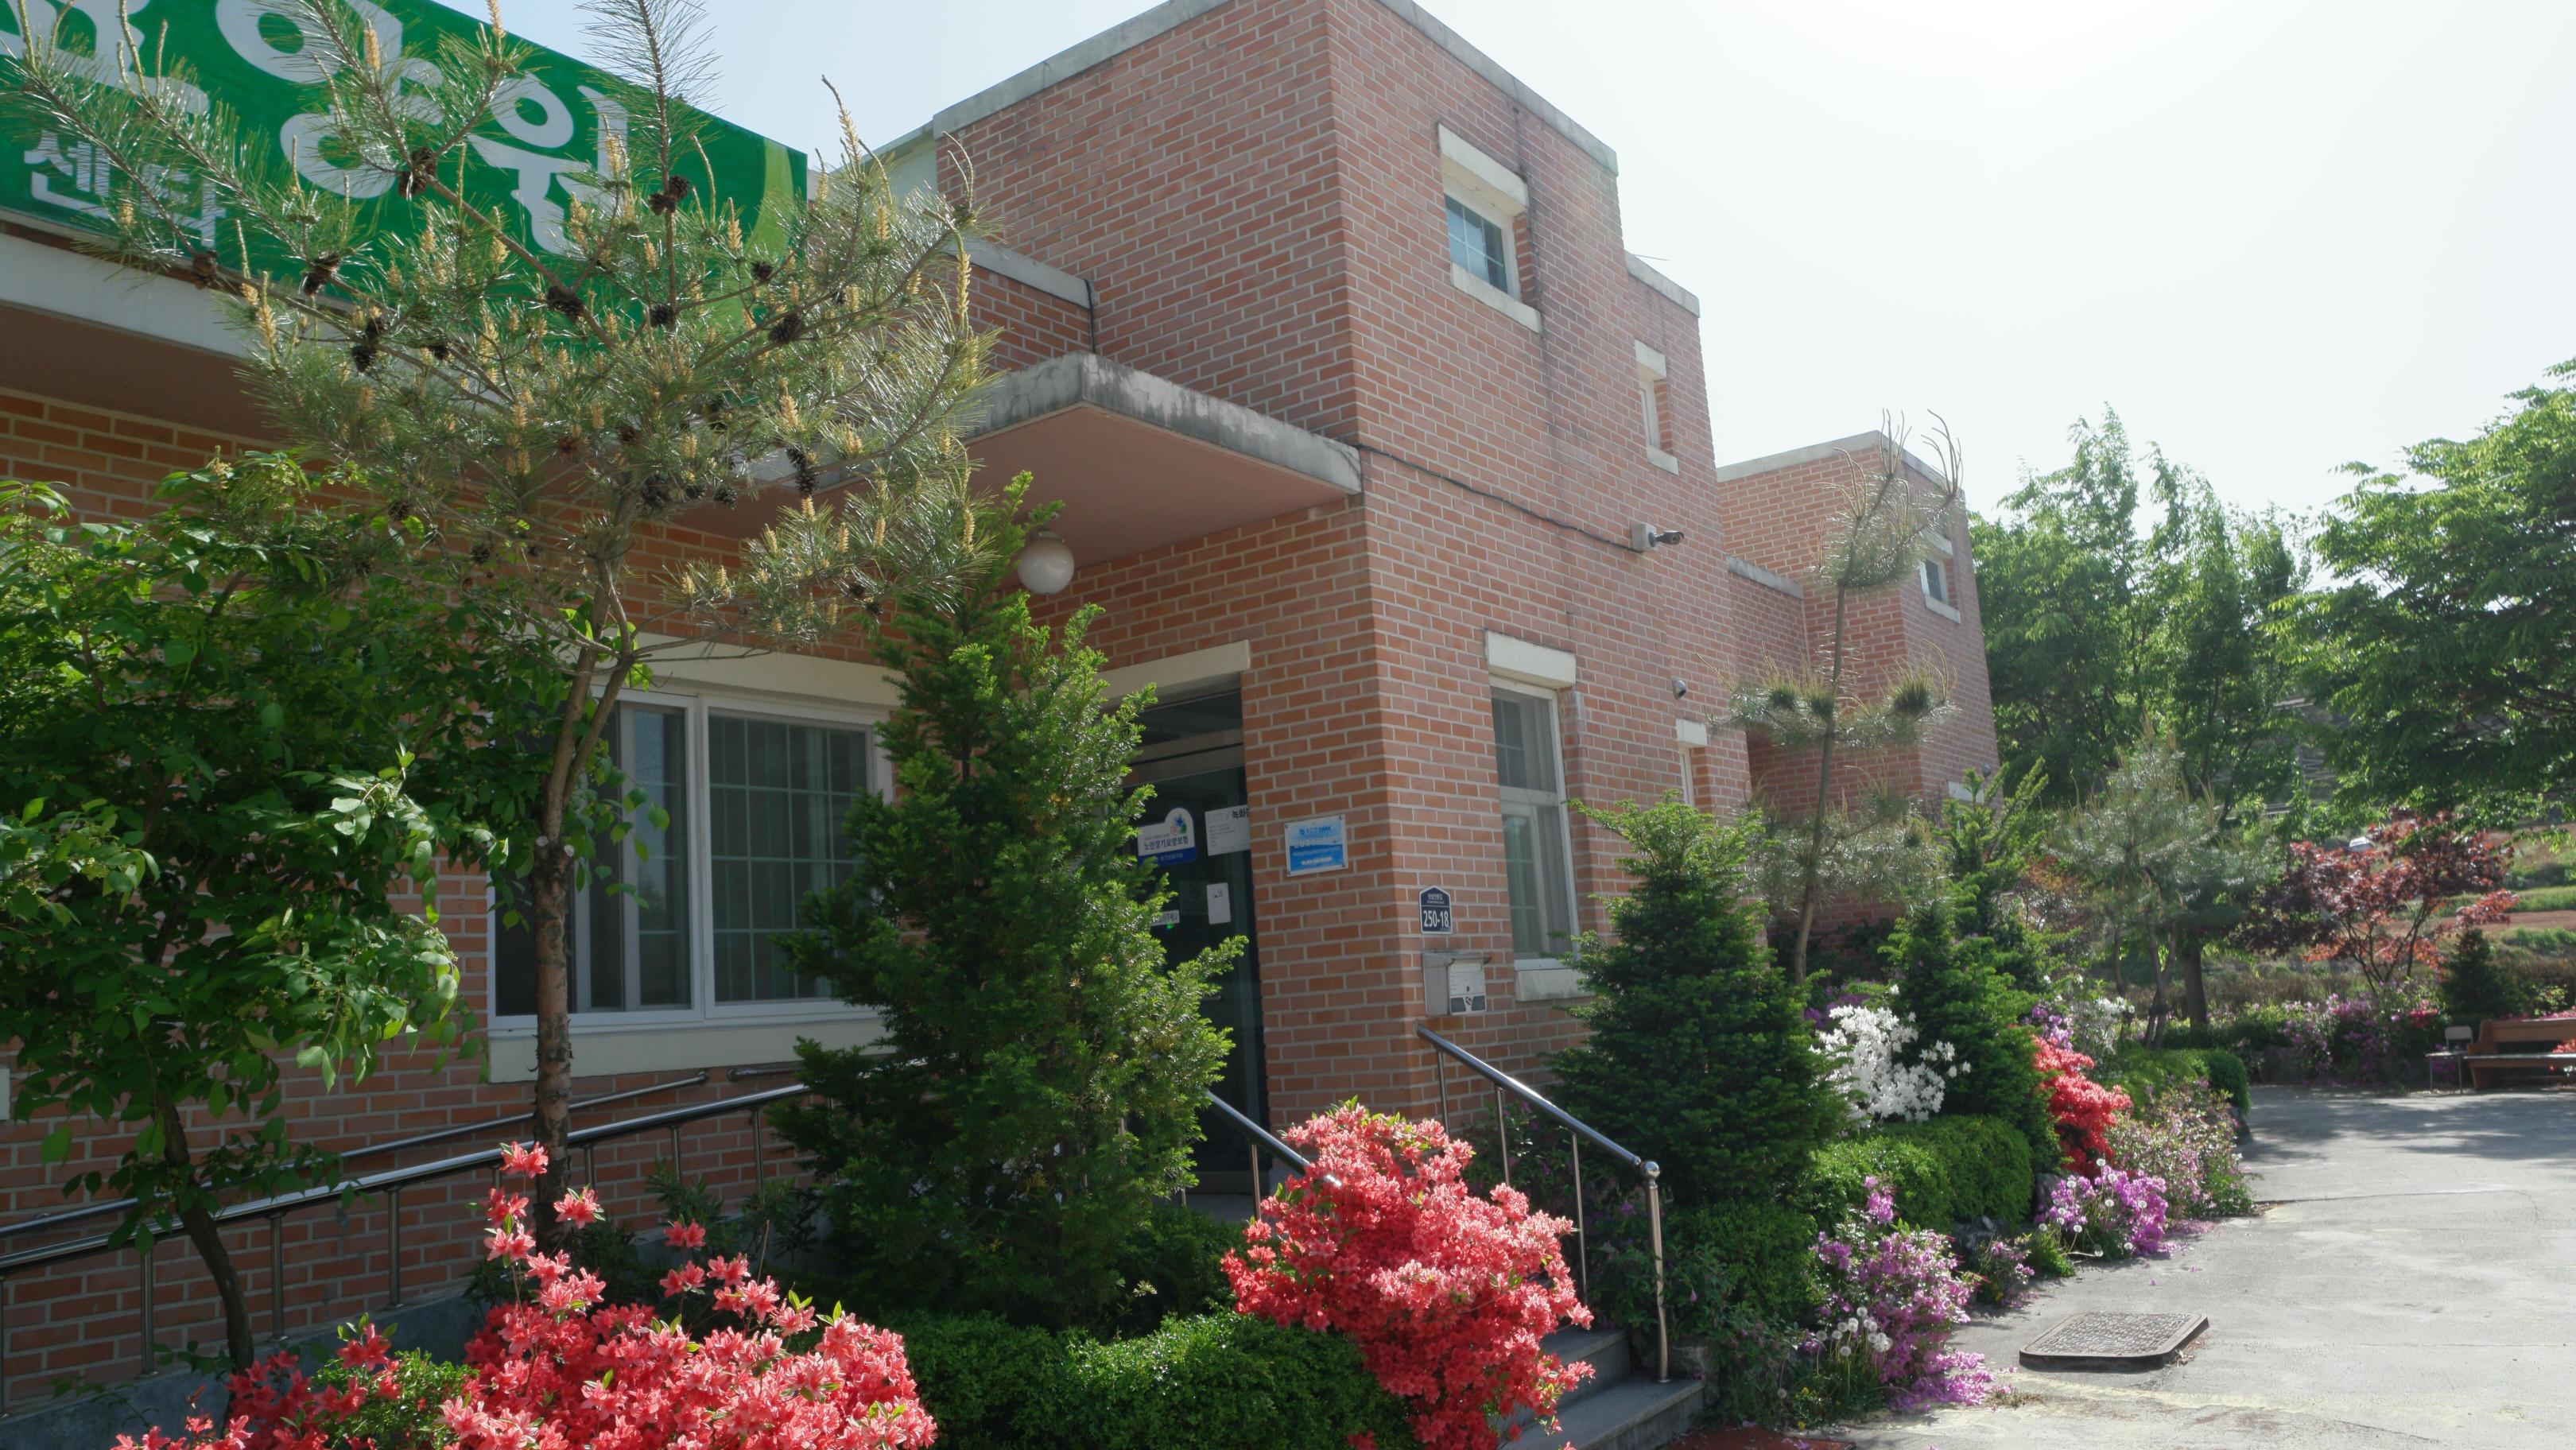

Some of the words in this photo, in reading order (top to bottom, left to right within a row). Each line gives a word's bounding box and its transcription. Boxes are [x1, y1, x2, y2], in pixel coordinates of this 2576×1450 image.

[24, 130, 227, 249] 센터
[1144, 835, 1189, 851] 노인장기요양보험
[1423, 909, 1449, 929] 250-18
